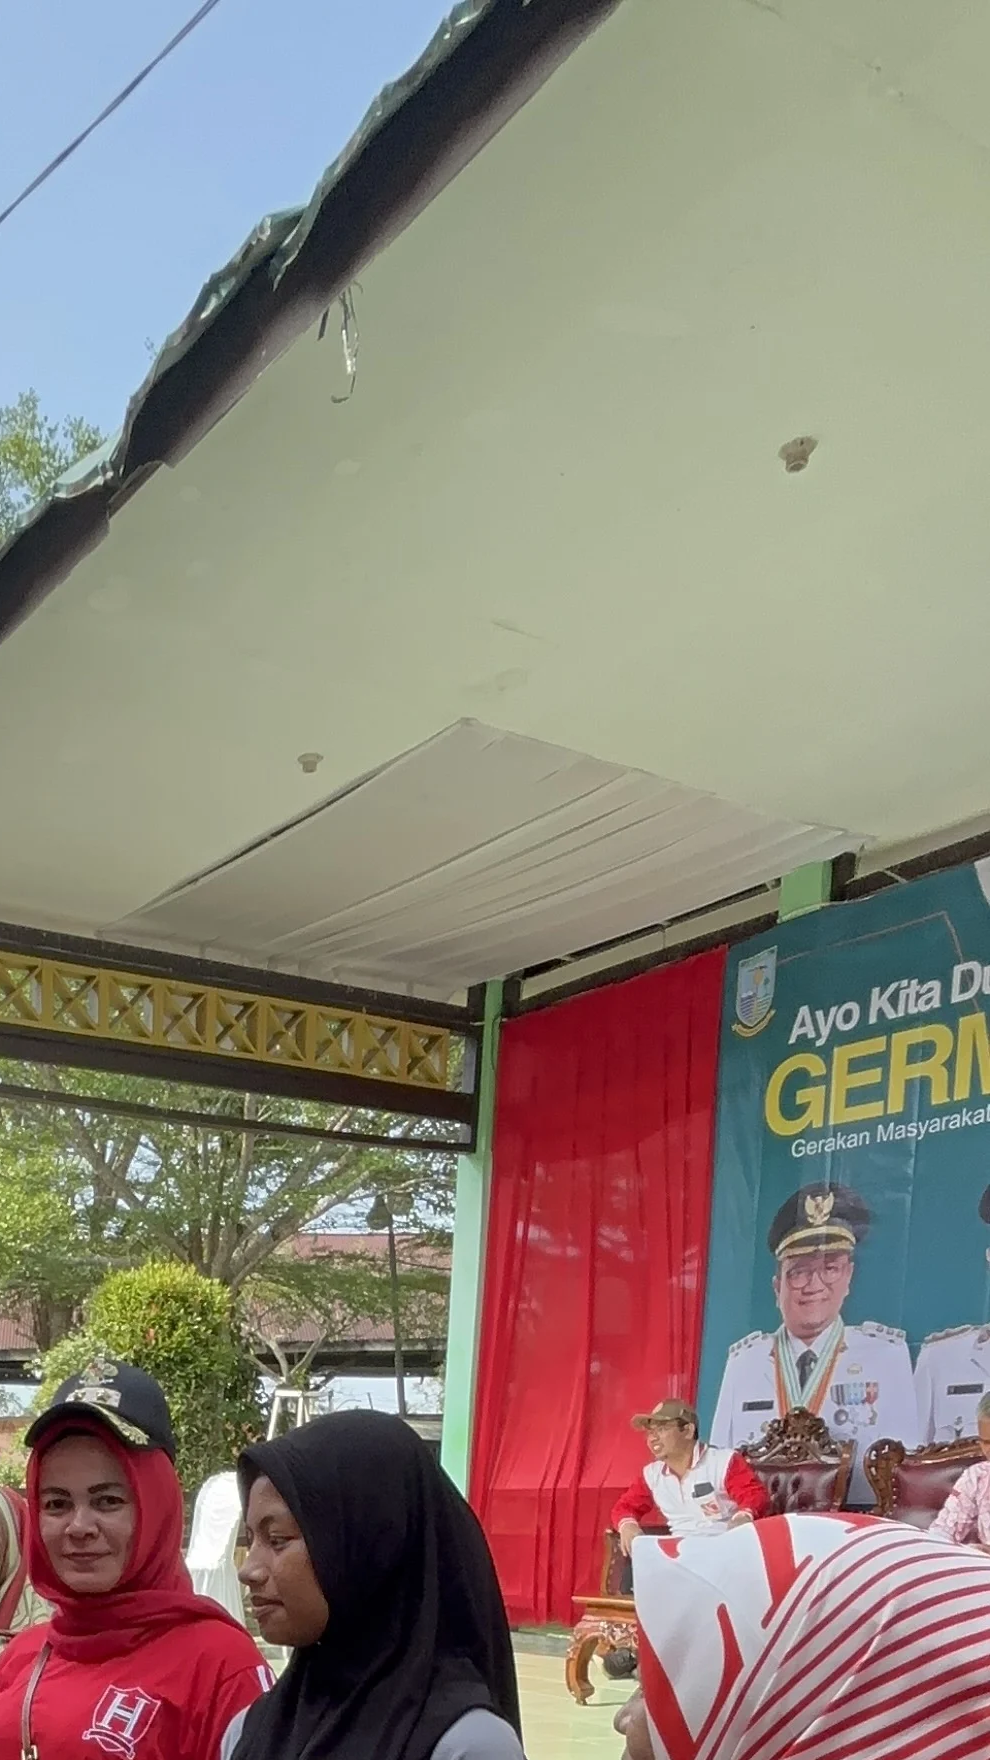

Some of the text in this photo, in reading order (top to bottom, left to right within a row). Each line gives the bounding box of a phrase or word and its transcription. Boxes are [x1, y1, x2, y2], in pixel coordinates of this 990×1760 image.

[788, 1000, 860, 1047] Ayo
[868, 978, 942, 1025] Kita
[791, 1130, 870, 1158] Gerakan
[96, 1691, 151, 1741] H
